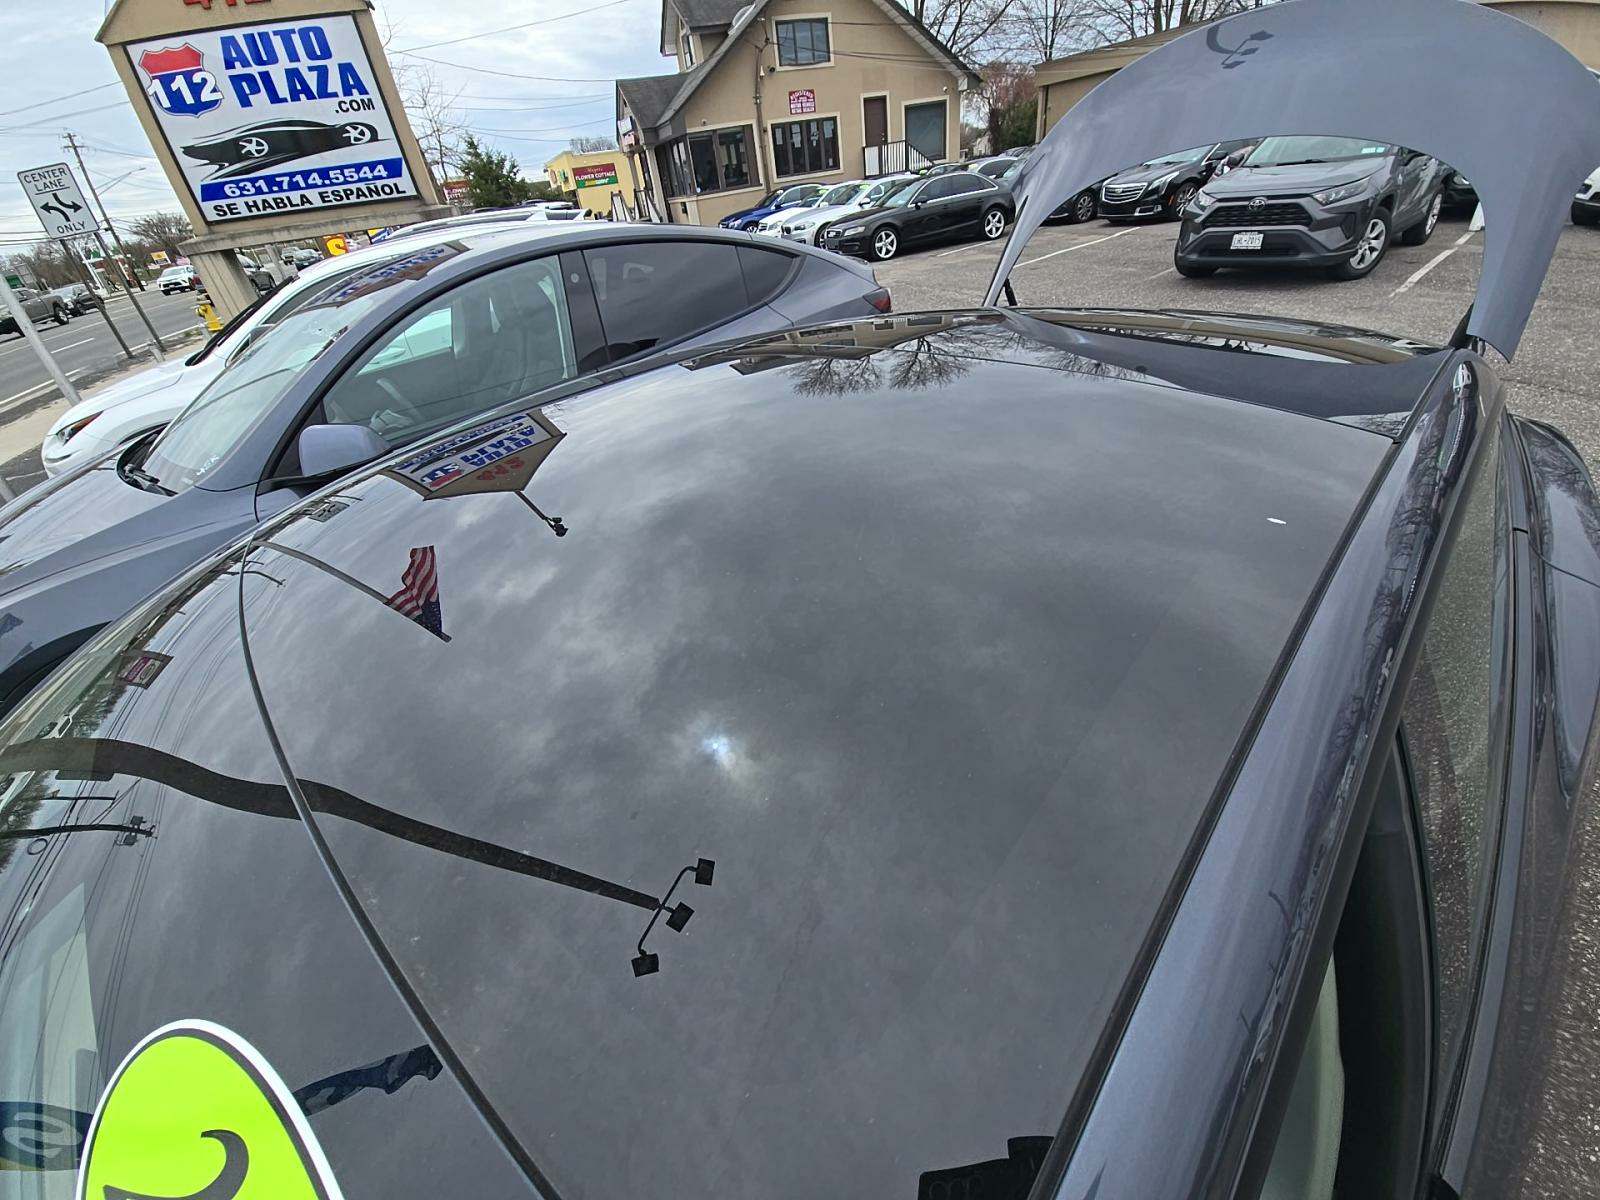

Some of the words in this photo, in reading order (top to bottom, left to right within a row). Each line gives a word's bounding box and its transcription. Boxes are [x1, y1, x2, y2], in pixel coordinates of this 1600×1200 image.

[220, 26, 333, 70] AUTO
[148, 71, 223, 108] 112
[228, 62, 370, 108] PLAZA
[335, 98, 376, 114] .COM
[24, 168, 67, 183] CENTER
[34, 179, 65, 192] LANE
[223, 164, 388, 197] 631.714.5544
[213, 203, 242, 217] SE
[244, 194, 313, 213] HABLA
[318, 182, 406, 204] ESPAÑOL
[56, 221, 85, 234] ONLY
